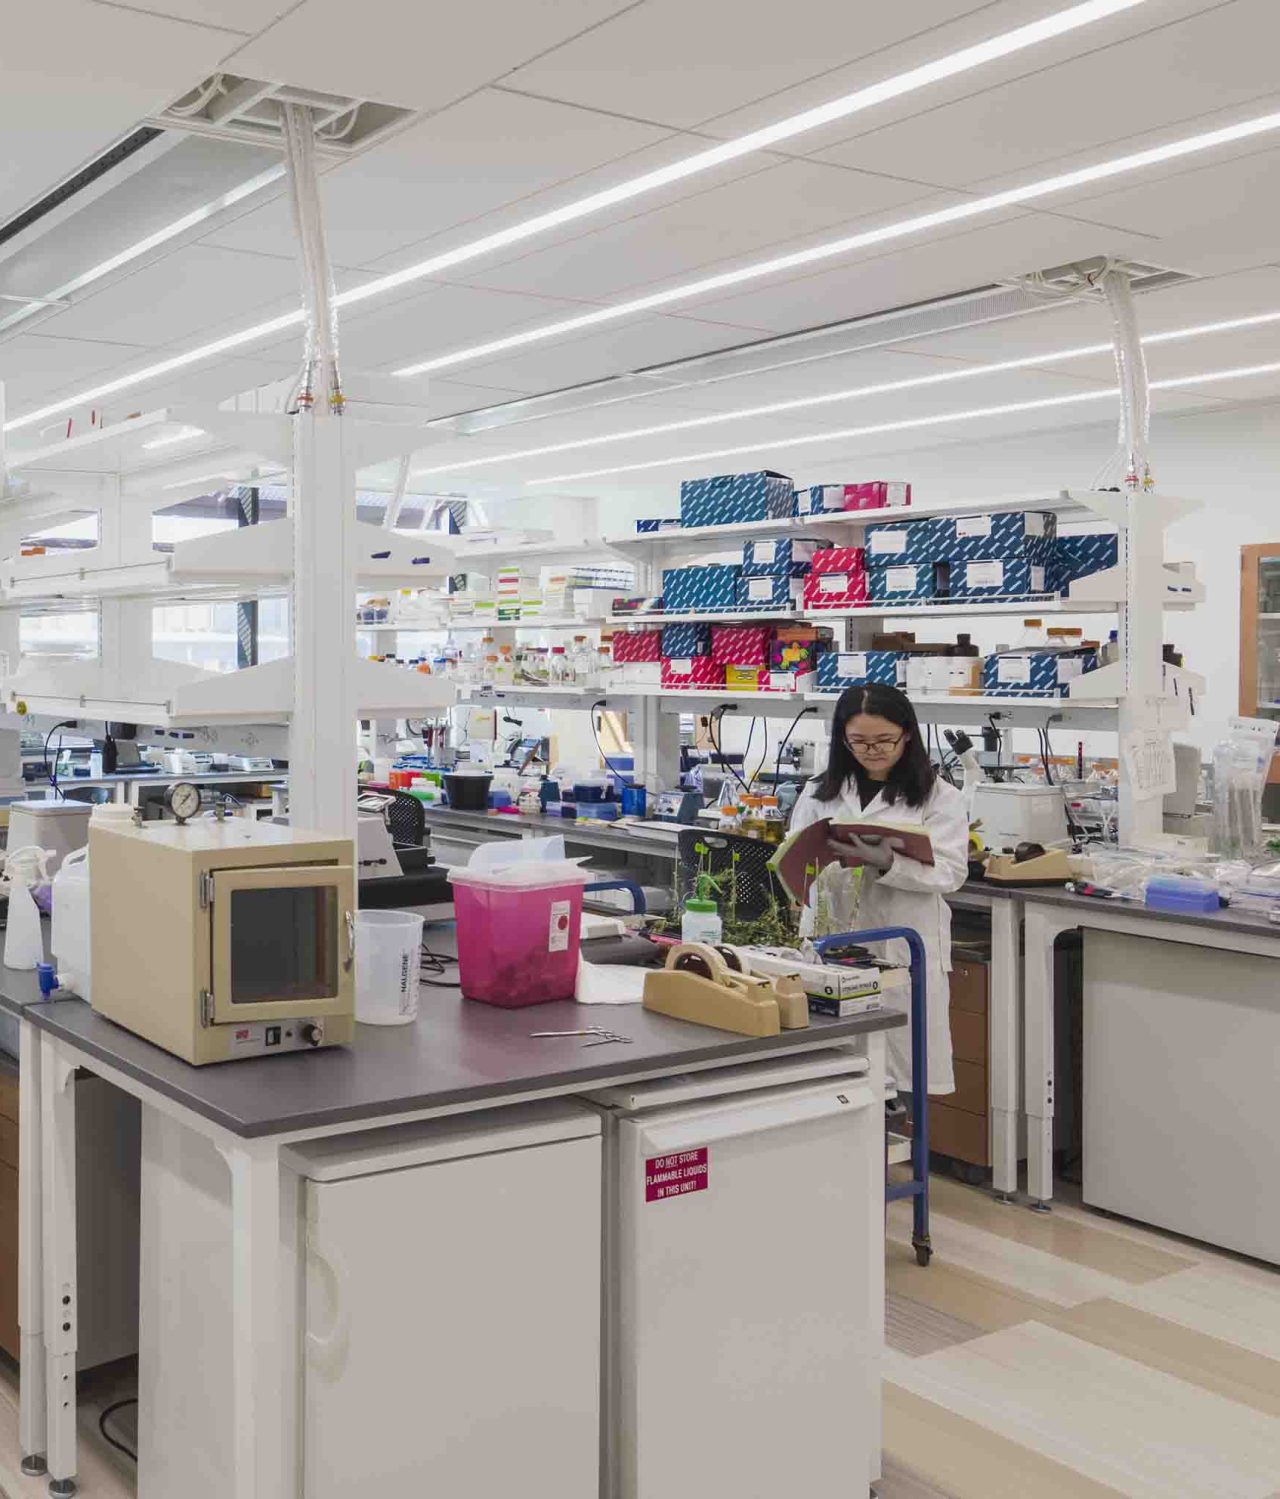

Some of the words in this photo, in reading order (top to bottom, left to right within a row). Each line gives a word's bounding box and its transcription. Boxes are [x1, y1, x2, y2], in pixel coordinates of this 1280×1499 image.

[655, 1159, 664, 1168] DO
[665, 1155, 678, 1167] NOT
[679, 1151, 698, 1163] STORE
[646, 1169, 682, 1185] FLAMMABLE
[683, 1164, 707, 1176] LIQUIDS
[657, 1187, 664, 1197] IN
[665, 1184, 679, 1195] THIS
[680, 1181, 696, 1192] UNIT!
